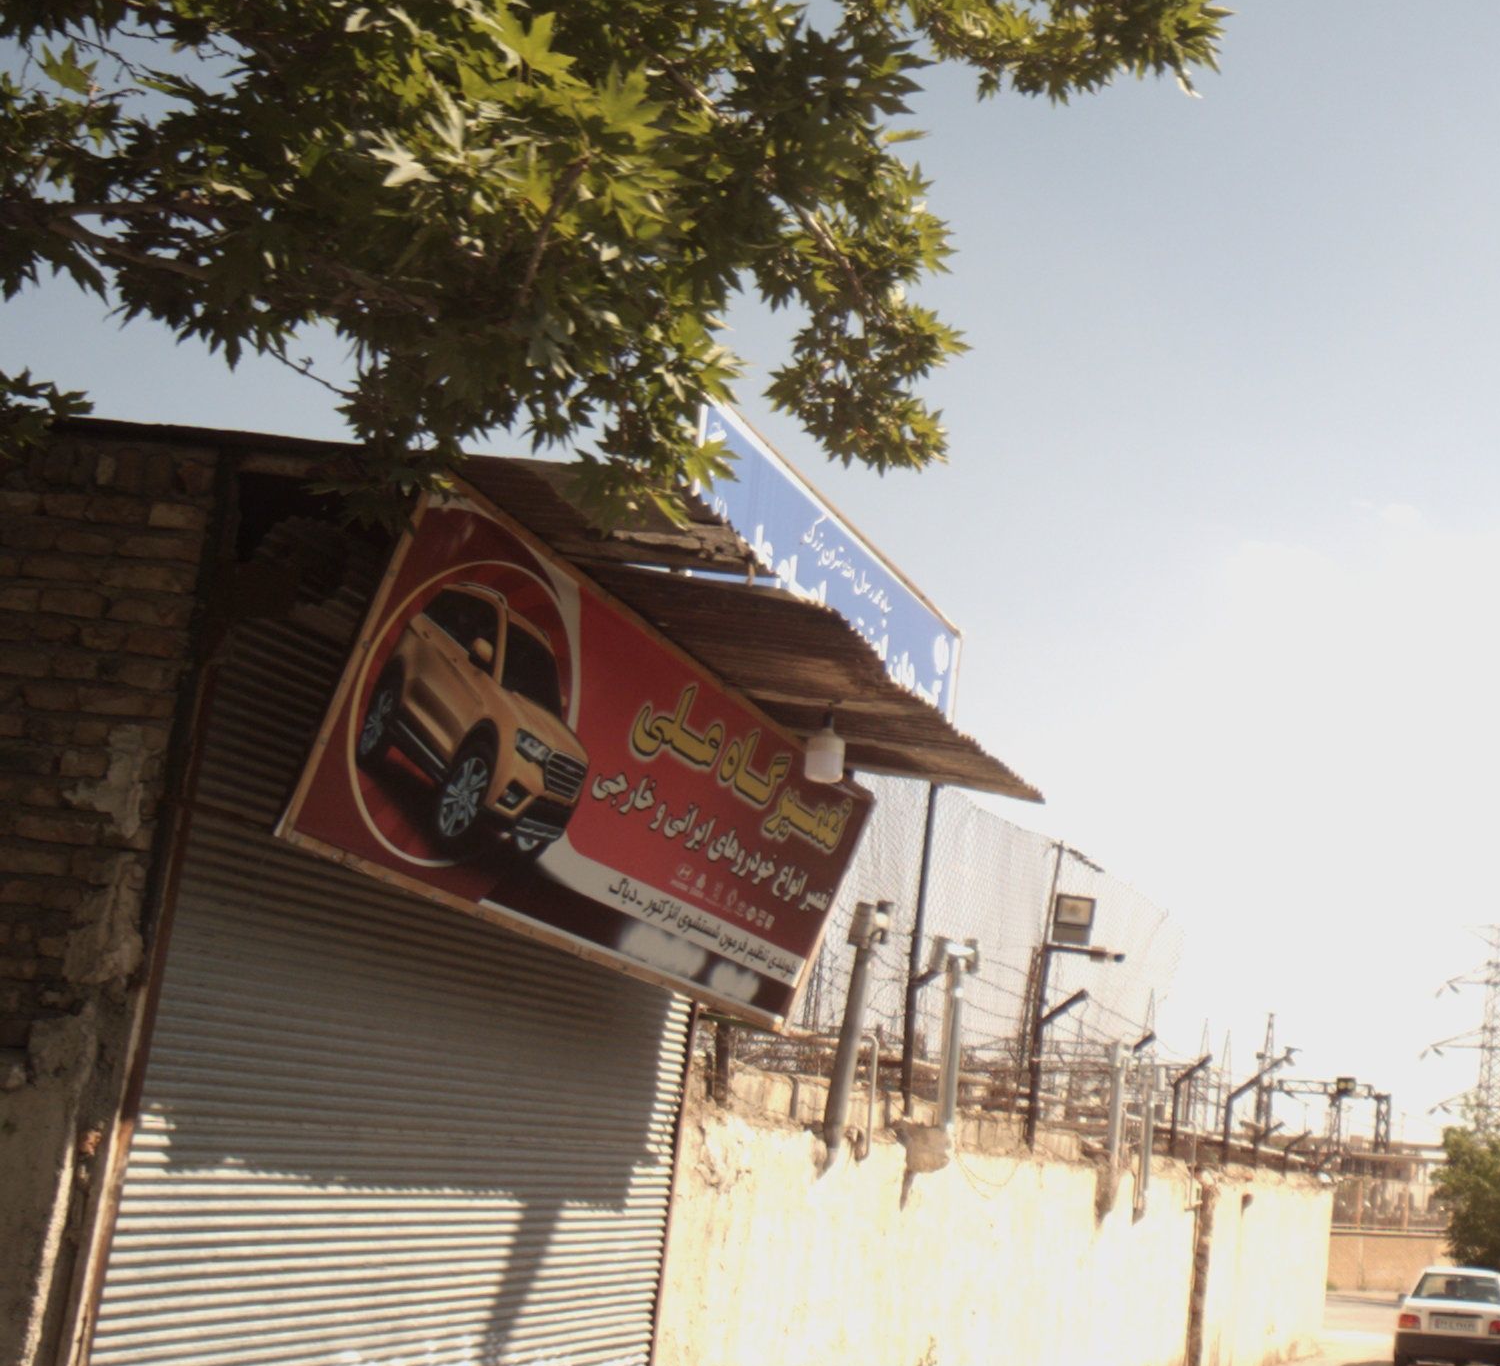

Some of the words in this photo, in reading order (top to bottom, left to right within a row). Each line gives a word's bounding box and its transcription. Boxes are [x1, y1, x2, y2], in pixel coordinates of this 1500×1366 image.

[631, 684, 724, 770] علی
[591, 772, 656, 814] خارجی
[650, 803, 667, 830] و
[663, 803, 716, 850] ایرانی
[707, 827, 777, 885] خودروهای
[608, 877, 637, 905] دیاگ
[772, 865, 808, 902] انواع
[799, 888, 834, 912] تعمیر
